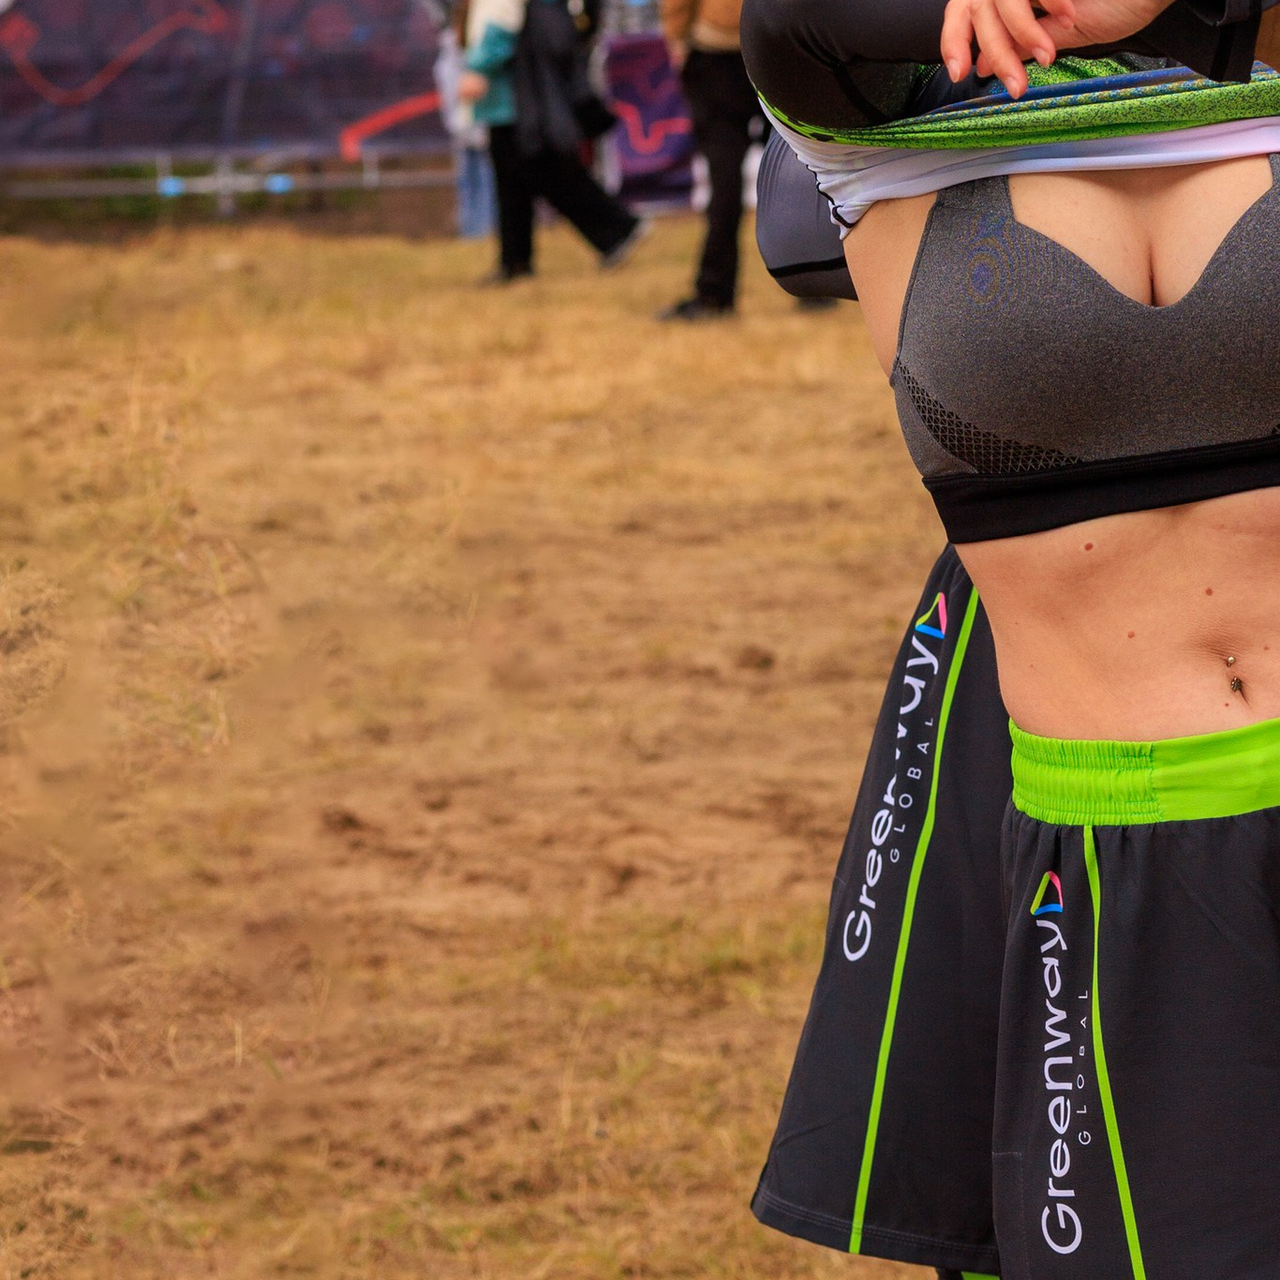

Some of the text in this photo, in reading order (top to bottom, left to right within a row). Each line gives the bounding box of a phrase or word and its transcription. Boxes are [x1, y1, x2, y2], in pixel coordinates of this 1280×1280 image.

[889, 717, 934, 864] GLOBAL
[1041, 918, 1083, 1255] Greenway
[1075, 989, 1092, 1146] GLOBAL
